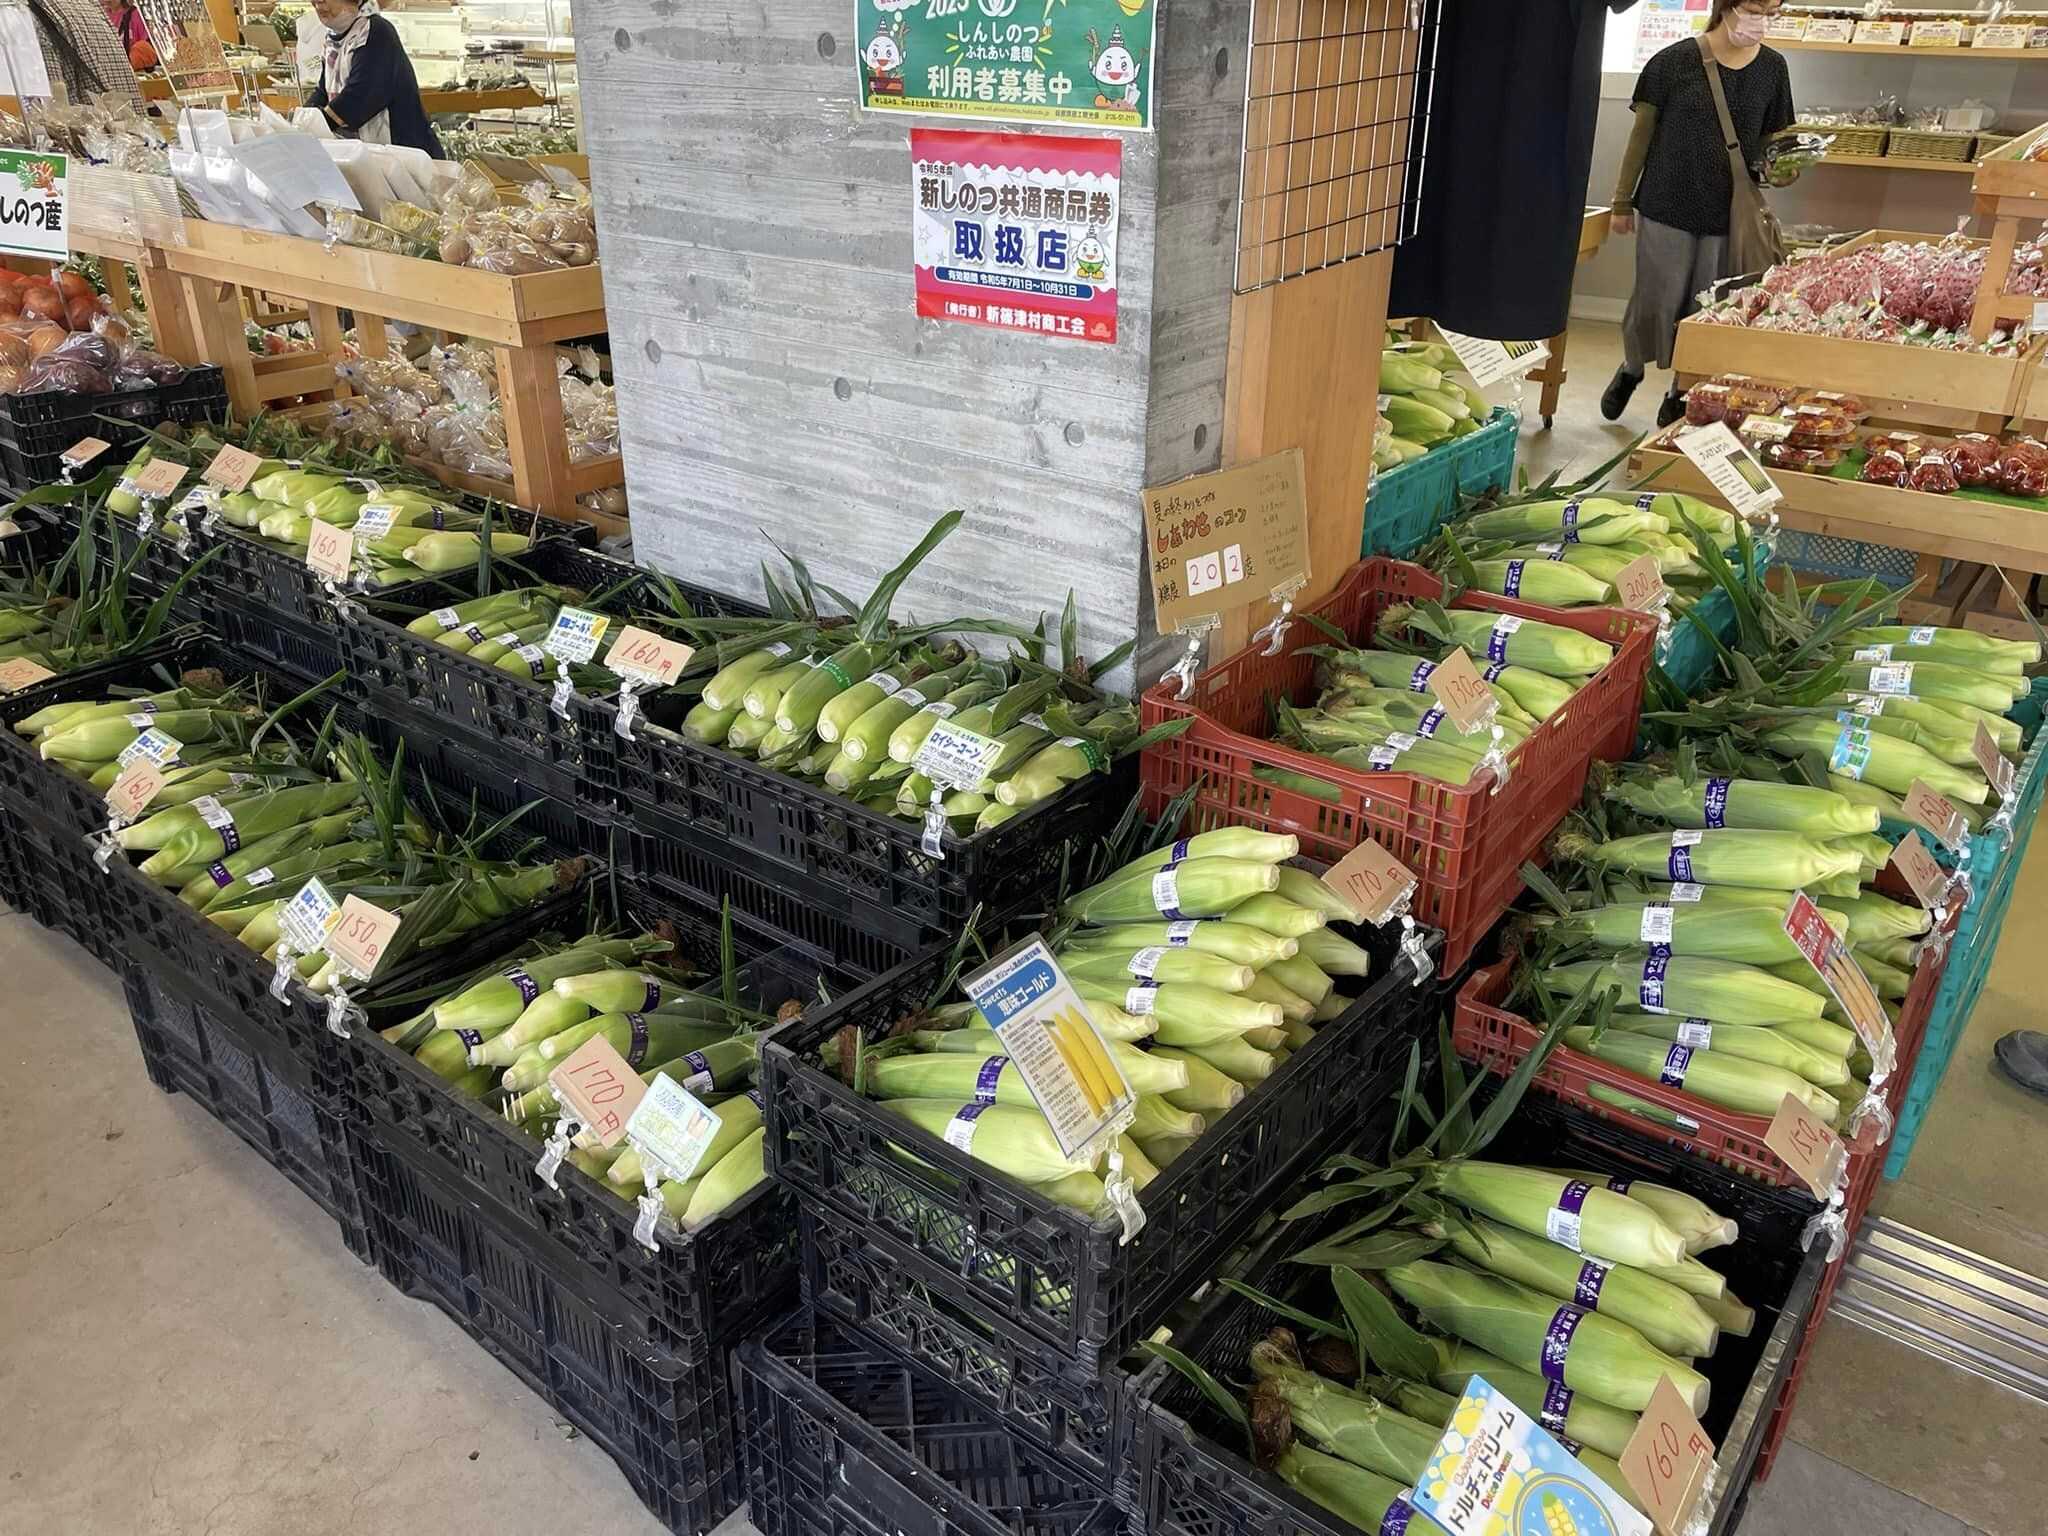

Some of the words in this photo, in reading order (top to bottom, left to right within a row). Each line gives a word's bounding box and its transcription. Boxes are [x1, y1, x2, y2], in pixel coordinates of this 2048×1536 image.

[958, 20, 1039, 44] しんしのつ
[965, 45, 1033, 62] ふれあい農園
[927, 65, 1072, 104] 利用者募集中
[920, 177, 1111, 225] 新しのつ共通商品券
[338, 912, 377, 944] 150
[1448, 1410, 1516, 1531] ドルチェドリーム
